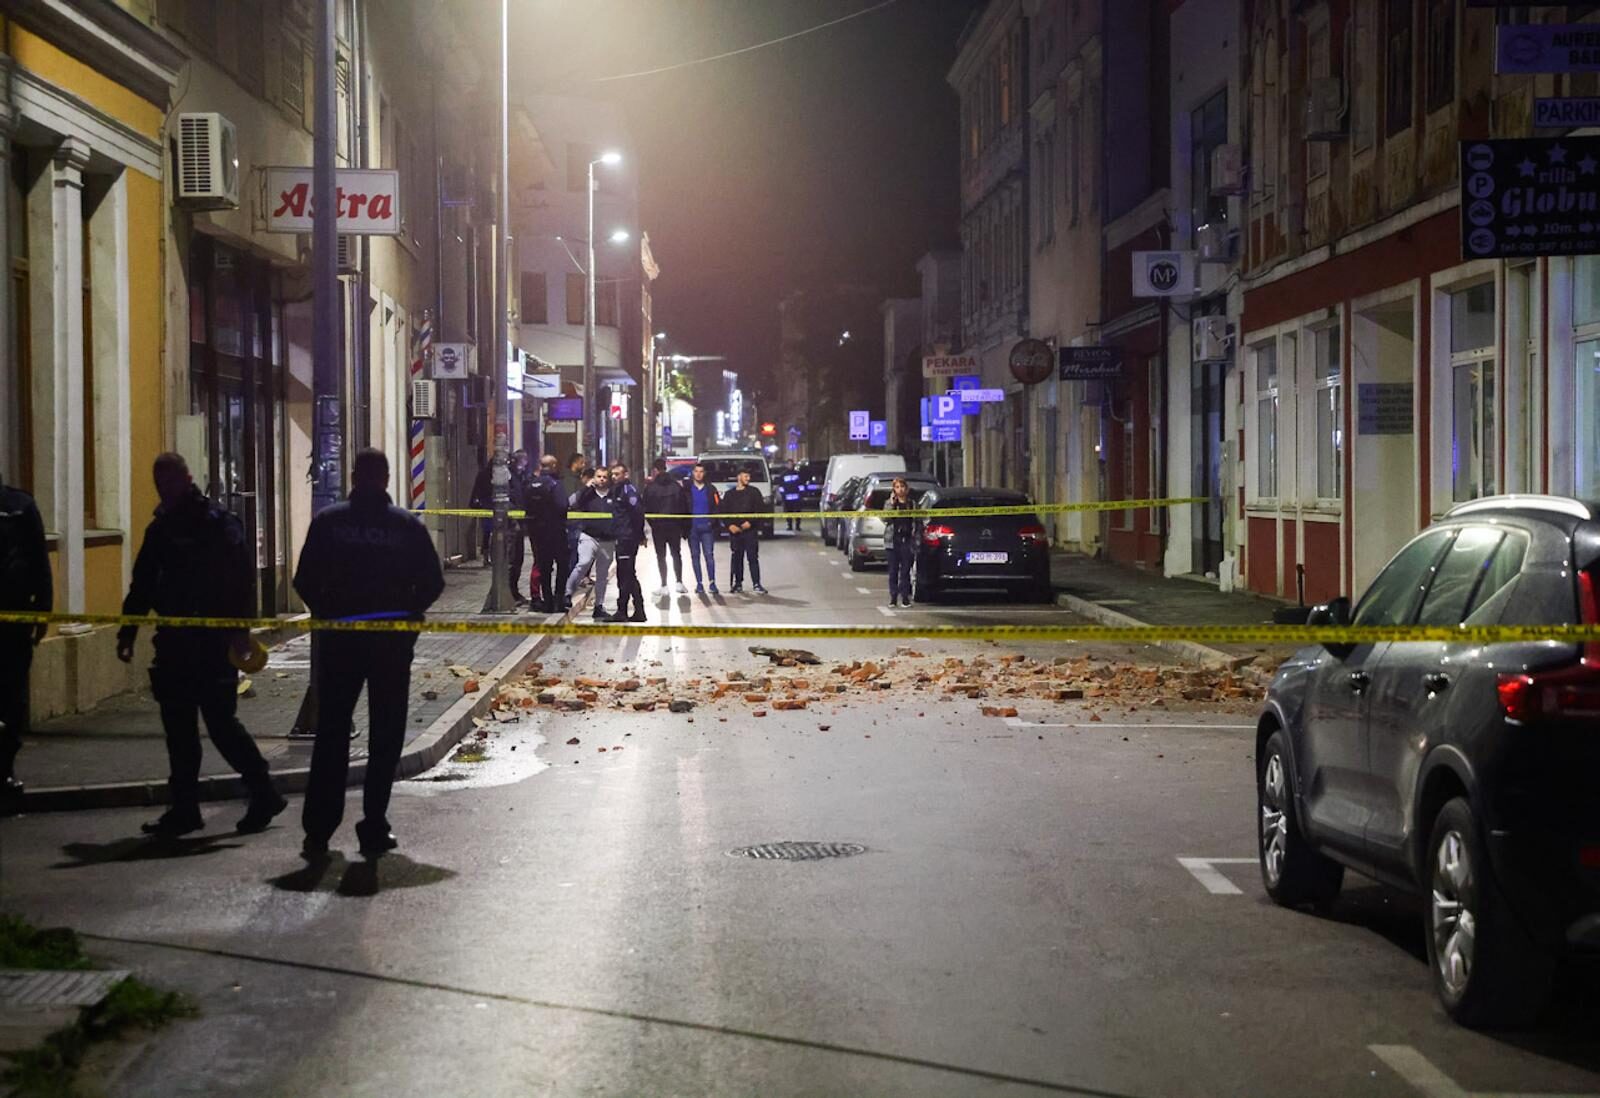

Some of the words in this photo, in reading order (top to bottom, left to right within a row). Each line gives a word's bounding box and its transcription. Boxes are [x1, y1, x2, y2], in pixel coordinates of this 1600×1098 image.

[272, 183, 393, 219] Atra
[926, 356, 976, 368] PEKARA
[938, 396, 954, 418] P
